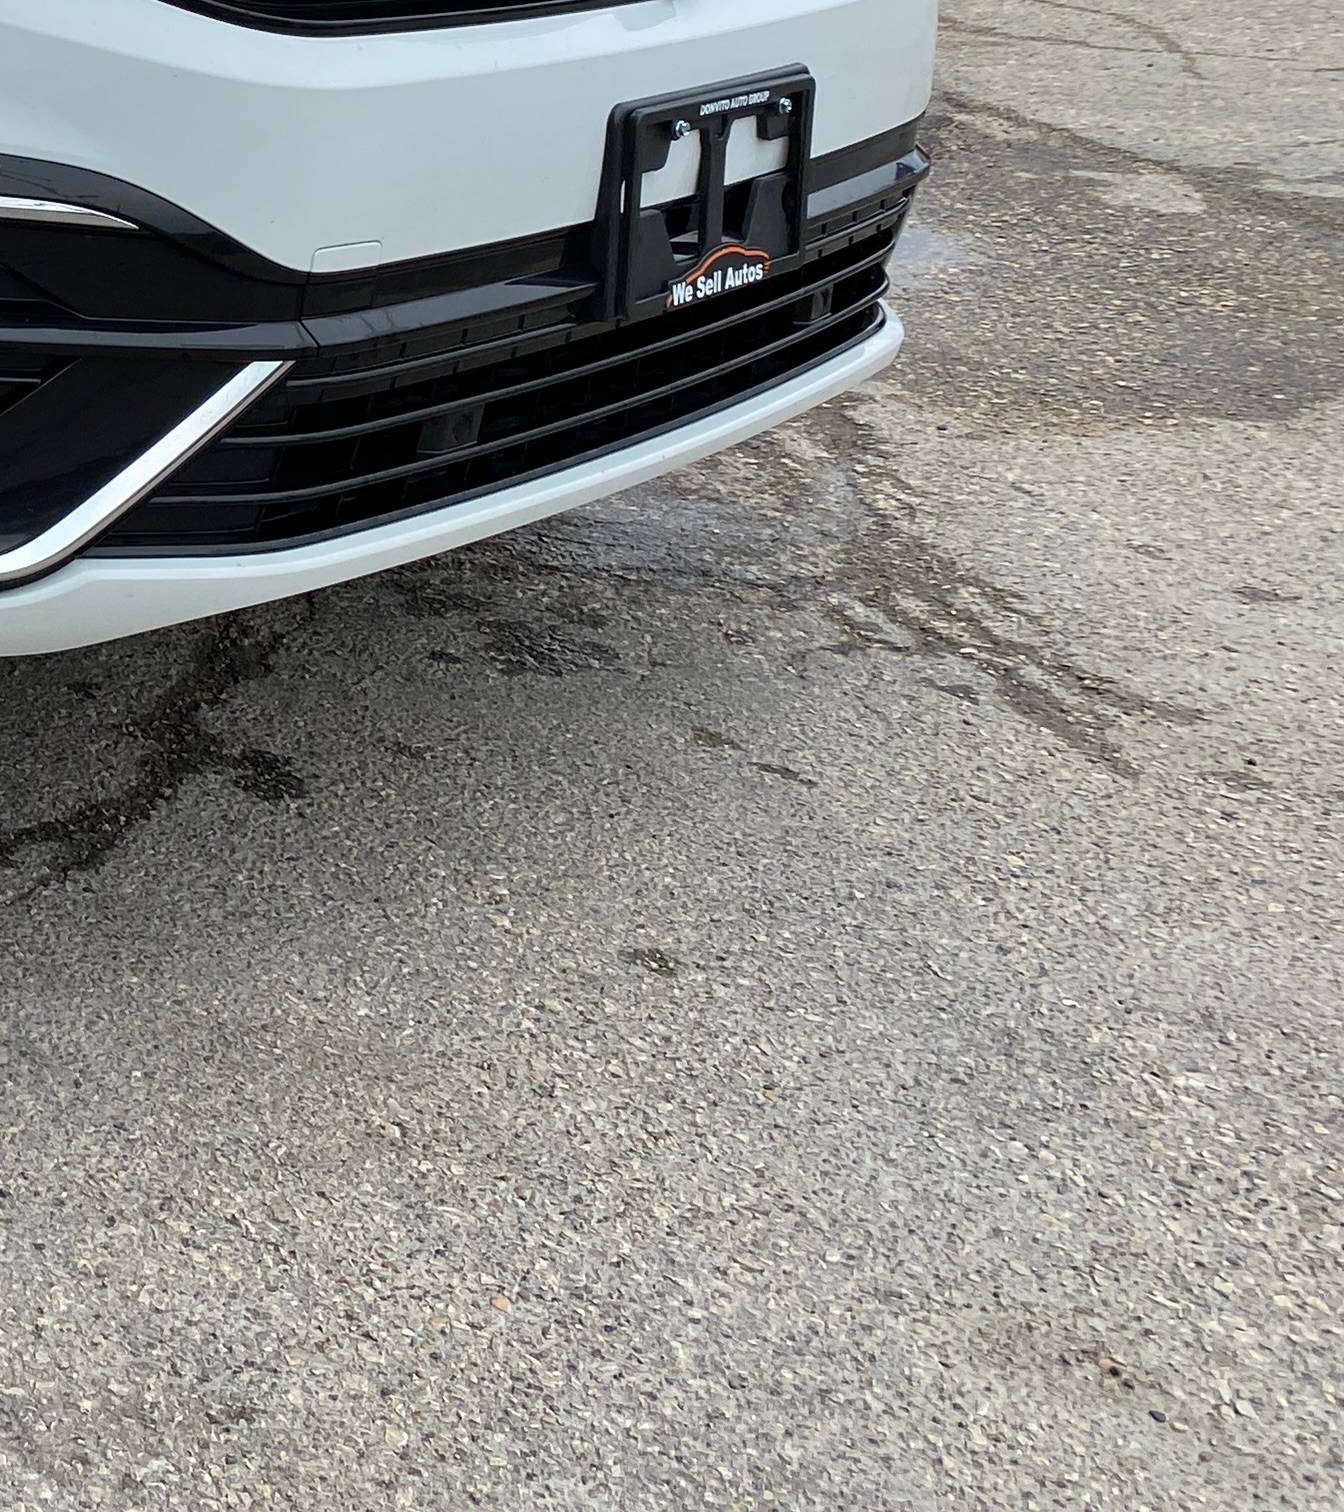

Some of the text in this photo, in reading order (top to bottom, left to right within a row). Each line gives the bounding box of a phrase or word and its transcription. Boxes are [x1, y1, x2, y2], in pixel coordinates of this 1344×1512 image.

[730, 94, 748, 109] AUTO
[748, 90, 770, 105] GROUP
[672, 263, 765, 307] We Sell Autos
